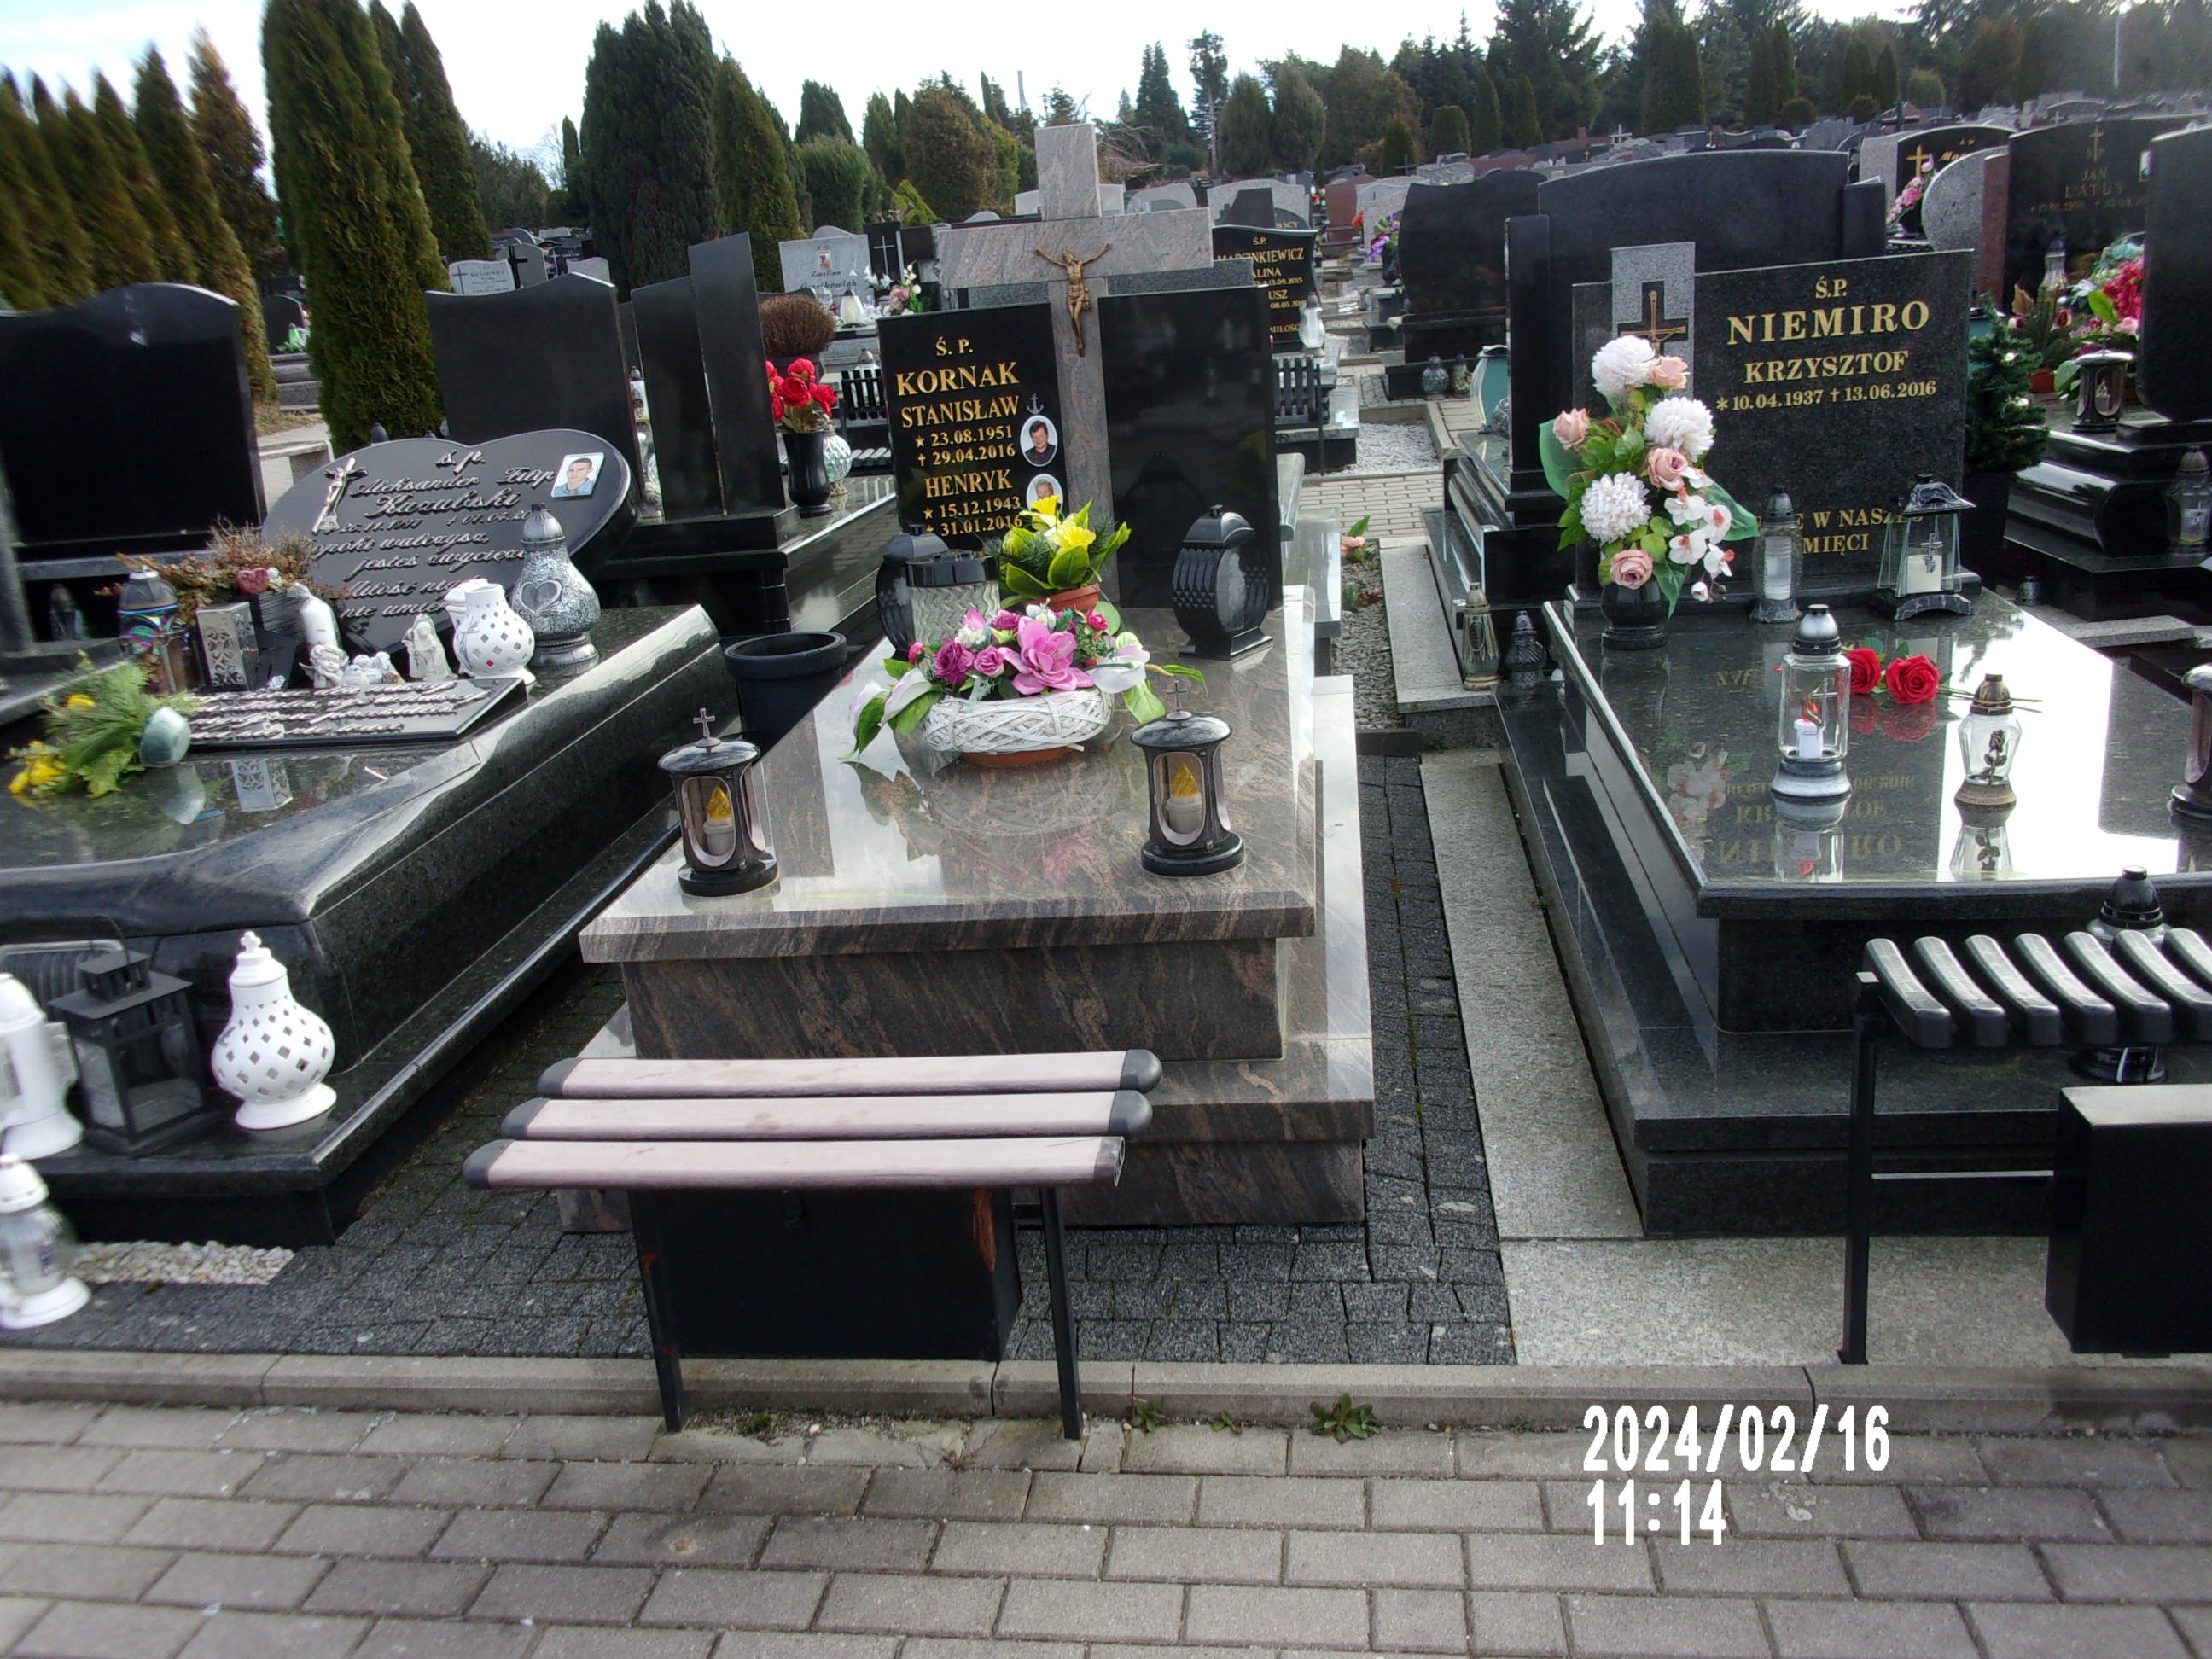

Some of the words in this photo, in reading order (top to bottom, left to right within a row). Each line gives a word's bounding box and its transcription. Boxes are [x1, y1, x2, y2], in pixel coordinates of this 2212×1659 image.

[1726, 300, 1930, 346] NIEMIRO
[896, 362, 1020, 396] KORNAK
[1744, 350, 1909, 384] KRZYSZTOF
[1732, 389, 1824, 411] 10.04.1937
[1844, 380, 1936, 403] 13.06.2016
[901, 395, 1020, 428] STANISŁAW
[930, 425, 1013, 447] 23.08.1951
[933, 443, 1016, 465] 29.04.2016
[924, 469, 1013, 498] HENRYK
[940, 496, 1021, 518] 15.12.1943
[941, 515, 1023, 537] 31.01.2016
[1813, 511, 1831, 529] W
[340, 606, 378, 619] nie
